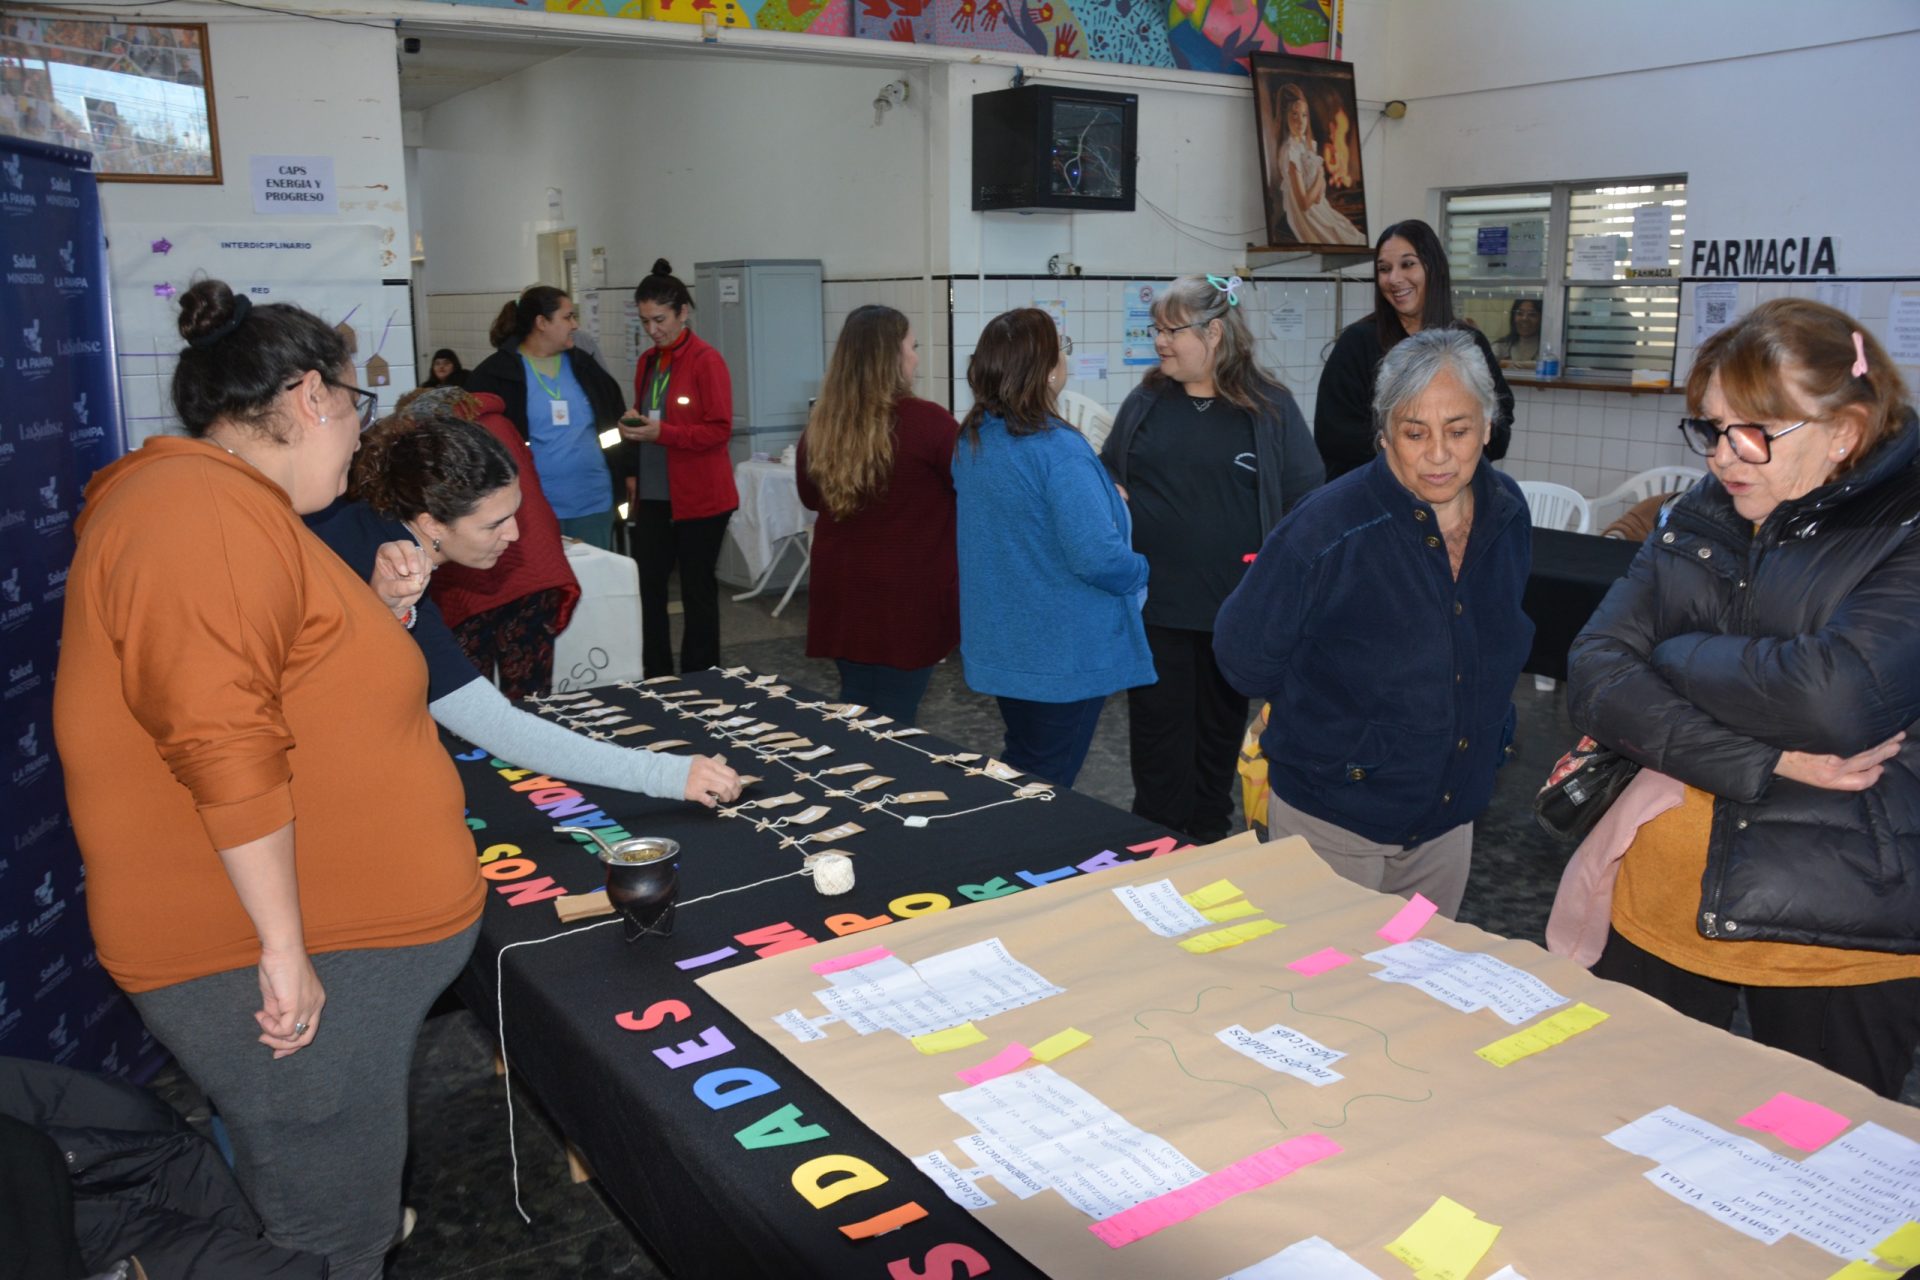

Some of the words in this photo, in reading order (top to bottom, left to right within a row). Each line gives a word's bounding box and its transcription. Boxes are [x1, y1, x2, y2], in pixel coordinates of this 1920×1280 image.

[50, 177, 72, 193] Salud
[266, 179, 312, 188] ENERGIA
[315, 180, 321, 189] Y
[279, 166, 307, 176] CAPS
[265, 192, 324, 202] PROGRESO
[13, 254, 36, 269] Salud
[1691, 236, 1836, 276] FARMACIA
[7, 273, 45, 285] MINISTERIO
[16, 359, 28, 370] LA
[34, 514, 45, 528] LA
[9, 660, 34, 684] Salud
[1229, 1029, 1330, 1077] necesidades
[971, 1135, 1040, 1190] conmemoración
[1160, 1146, 1205, 1177] (Duelos)
[928, 1154, 987, 1206] Celebración
[1050, 1175, 1096, 1210] Proyectos
[1116, 1189, 1133, 1199] el
[1660, 1171, 1703, 1200] Vital
[1712, 1200, 1778, 1235] Sentido
[1732, 1196, 1851, 1253] Autenticidad
[1756, 1191, 1865, 1245] Creatividad
[1791, 1189, 1880, 1235] Propósito
